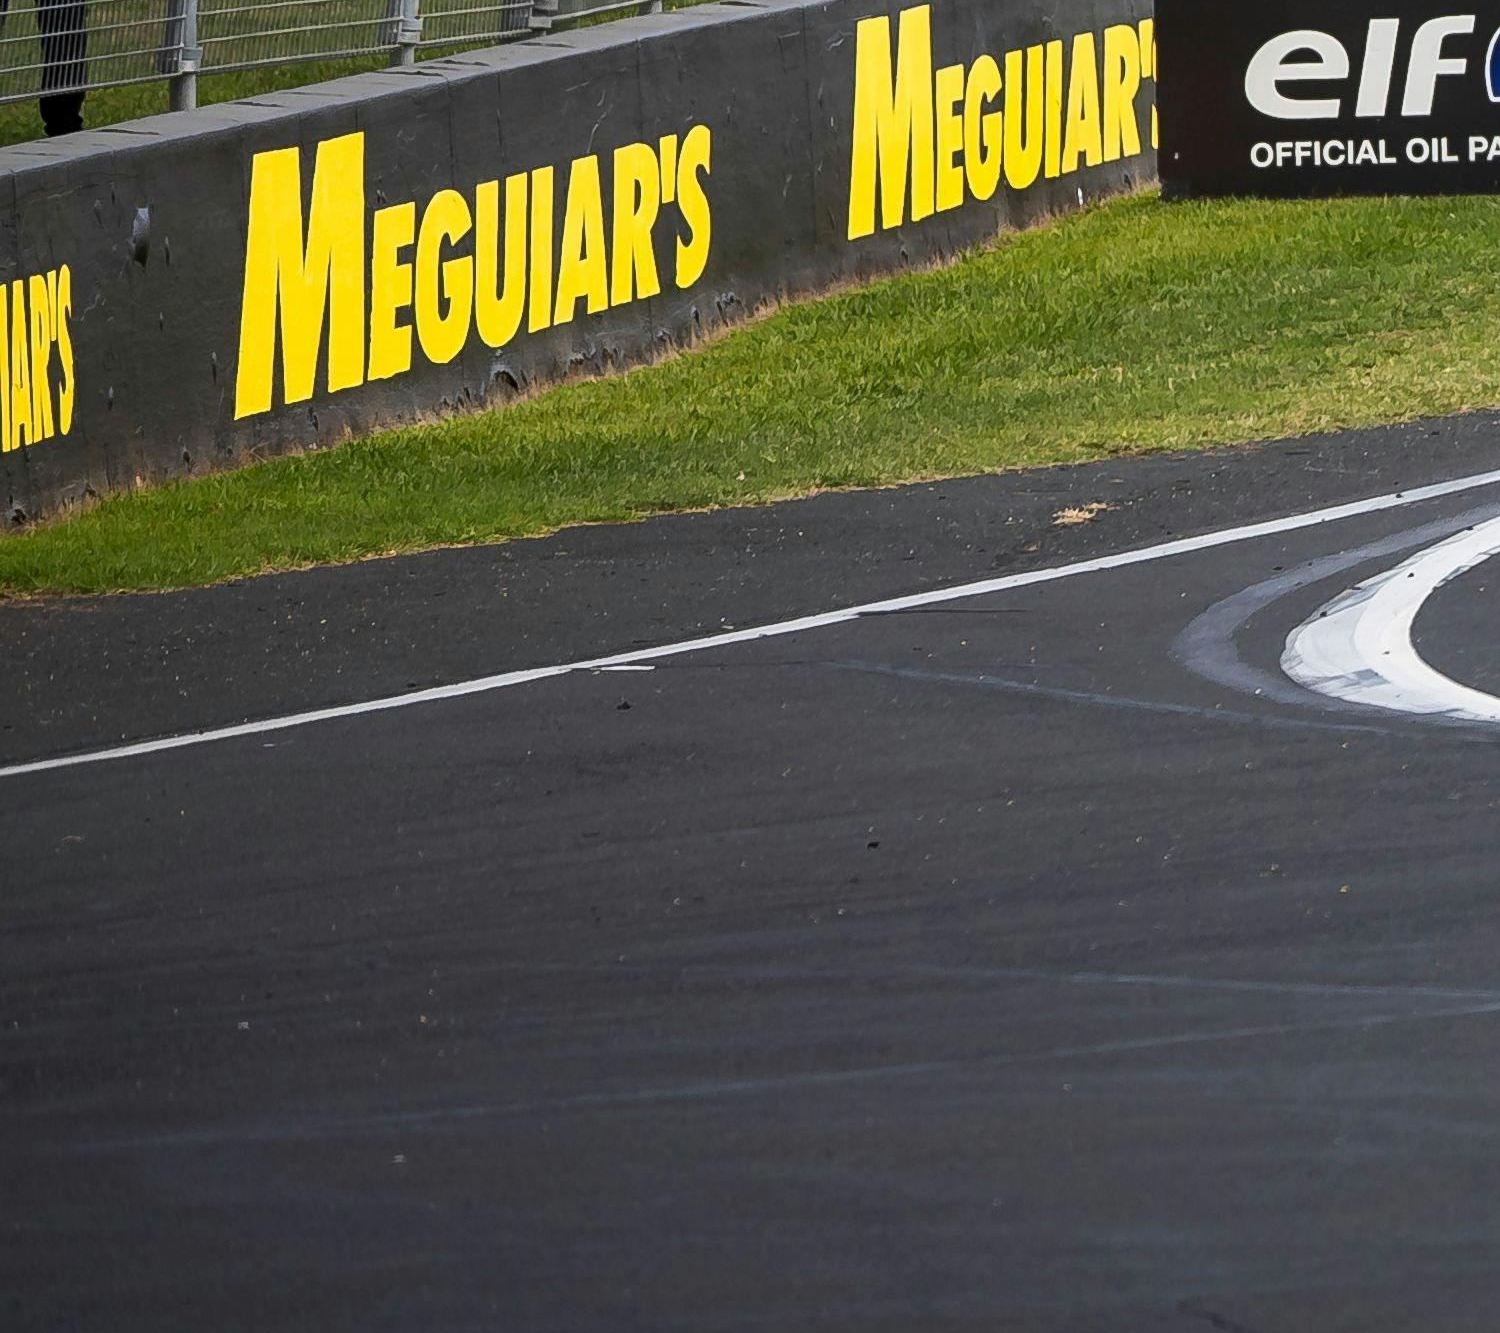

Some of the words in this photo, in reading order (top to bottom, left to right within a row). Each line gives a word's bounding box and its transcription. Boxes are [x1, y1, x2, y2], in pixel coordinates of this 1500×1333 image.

[1244, 14, 1477, 120] elf
[1250, 139, 1398, 169] OFFICIAL
[1405, 137, 1461, 165] OIL
[233, 124, 712, 420] MEGUIAR'S
